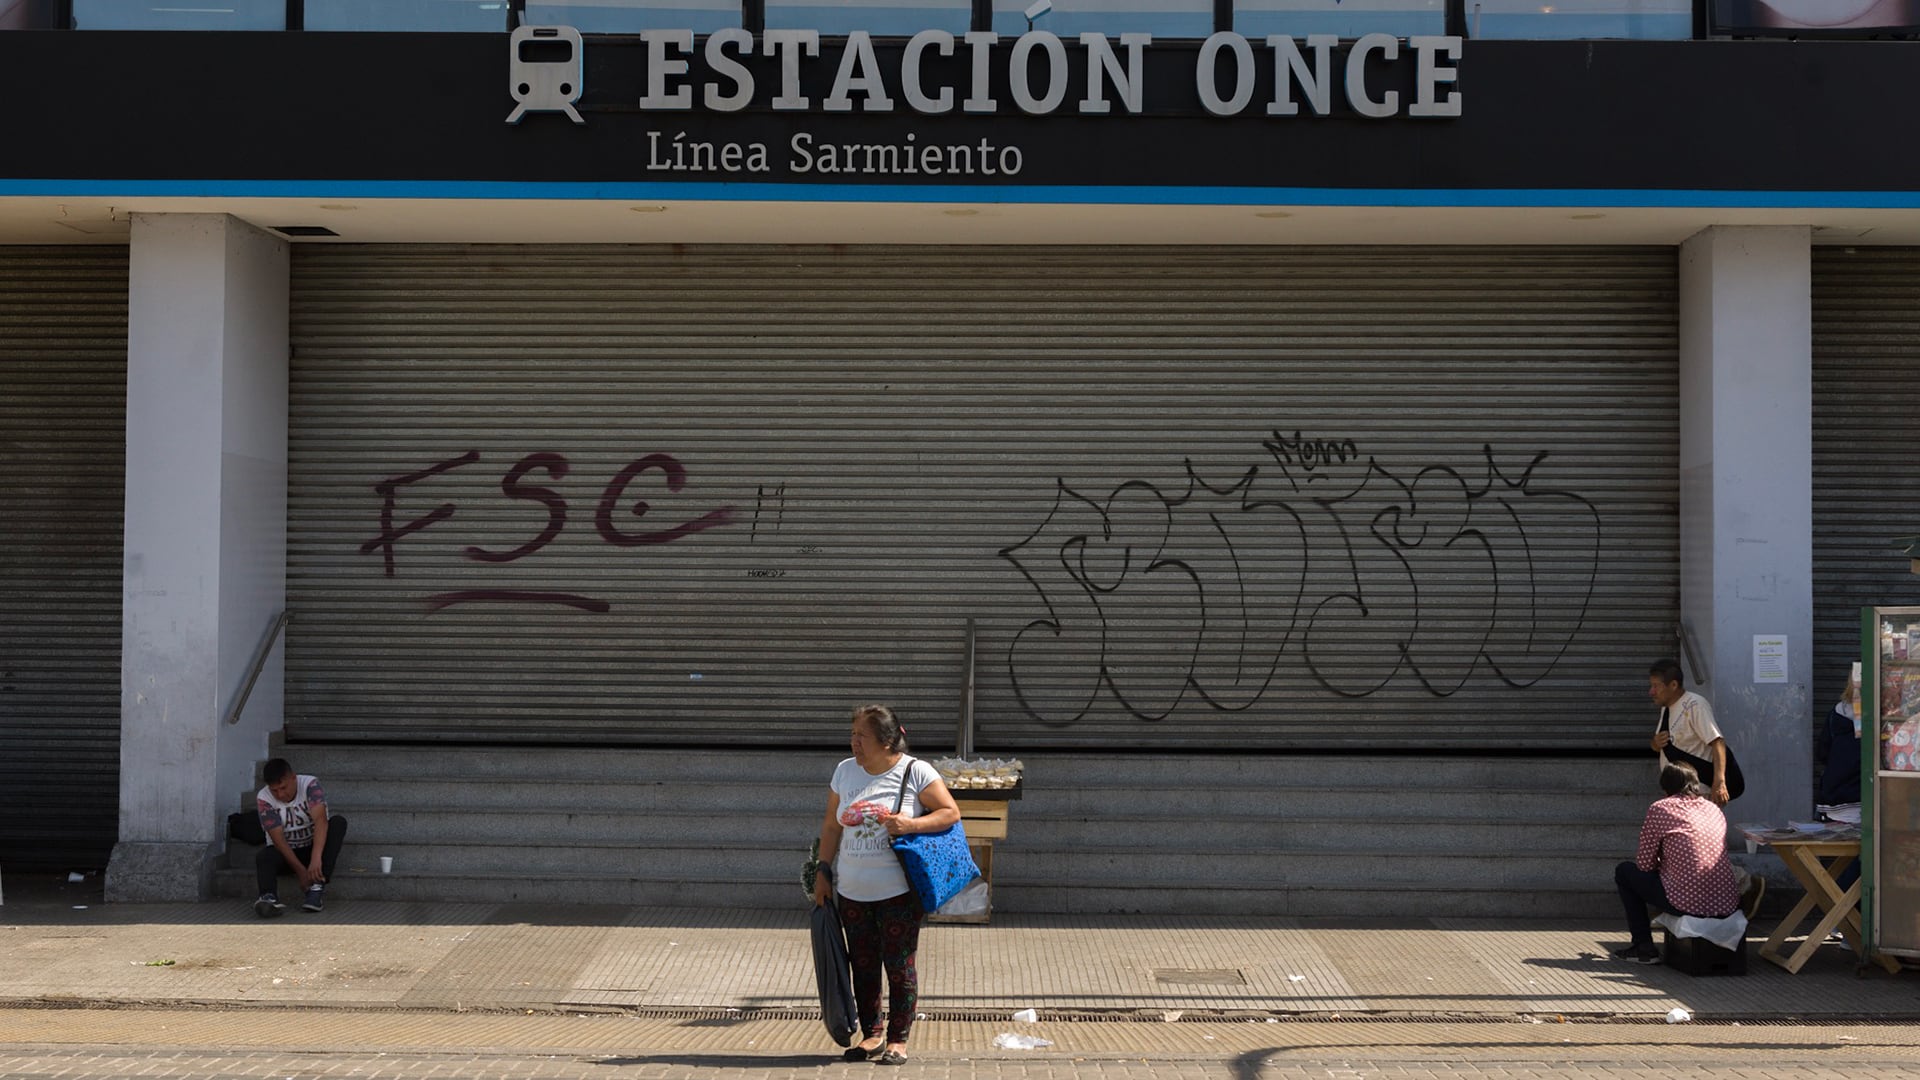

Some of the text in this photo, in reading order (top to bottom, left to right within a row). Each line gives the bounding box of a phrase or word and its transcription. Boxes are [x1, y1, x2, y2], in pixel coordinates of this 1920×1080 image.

[1196, 31, 1463, 118] ONCE
[646, 131, 1024, 176] Línea Sarmiento
